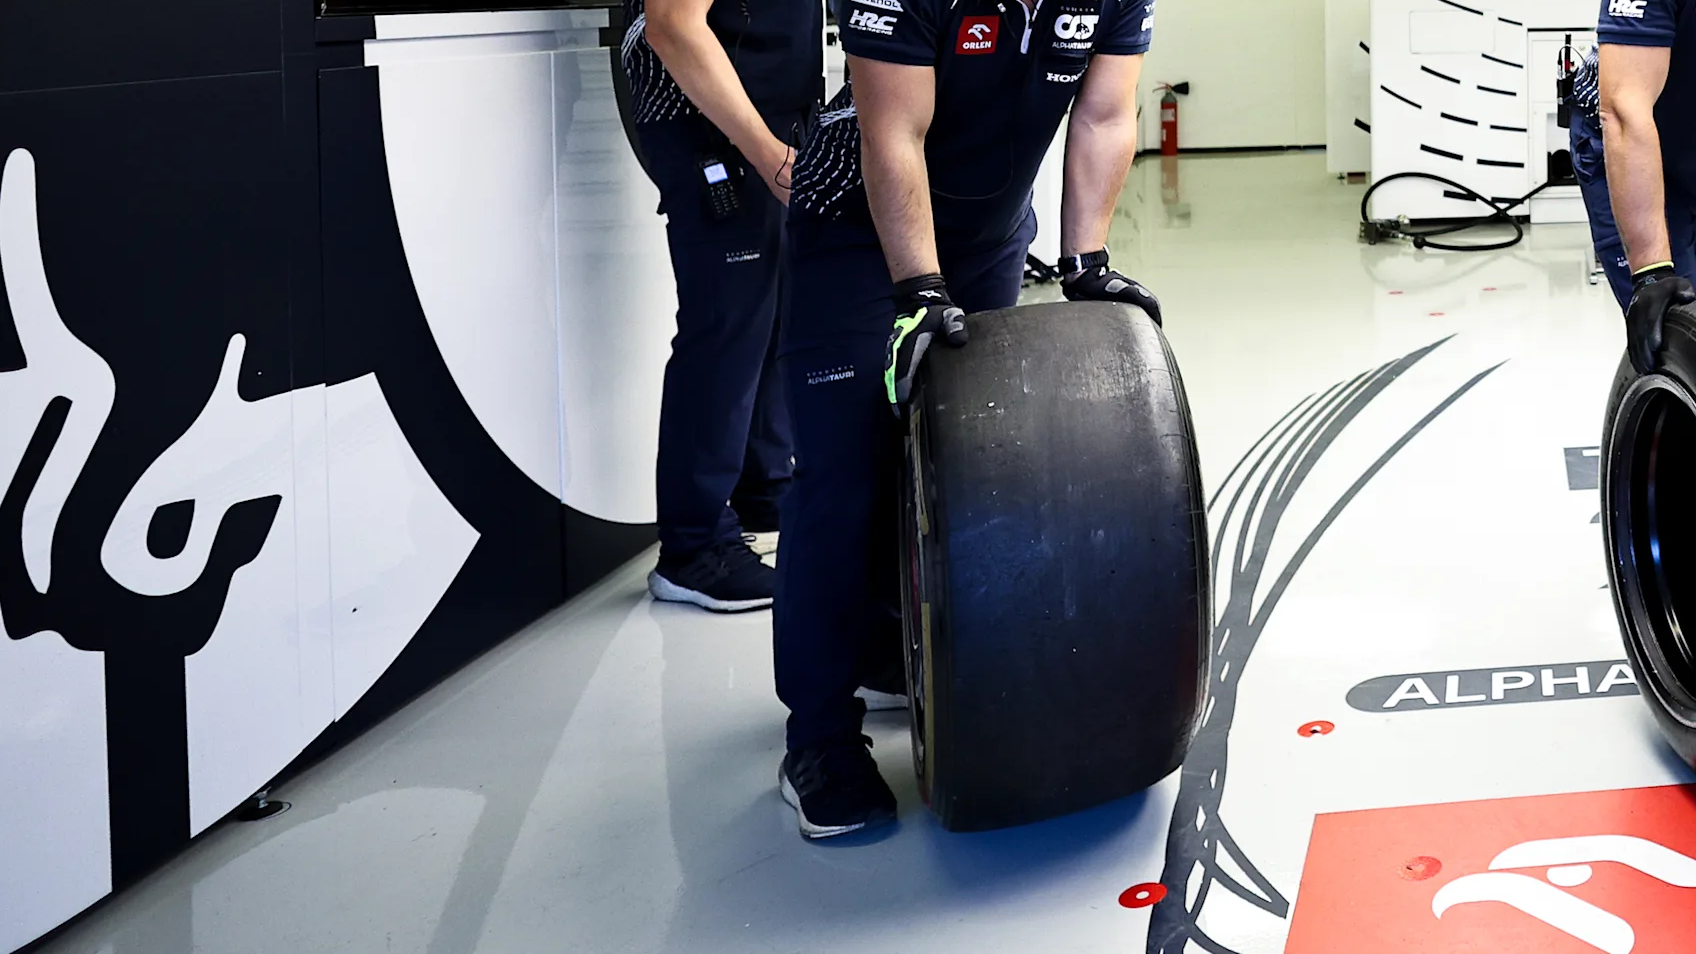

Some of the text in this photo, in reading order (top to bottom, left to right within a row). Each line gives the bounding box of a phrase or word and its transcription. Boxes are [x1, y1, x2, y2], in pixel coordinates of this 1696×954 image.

[848, 8, 898, 32] HRC
[962, 40, 992, 50] ORLEN
[1383, 662, 1641, 709] ALPHA
